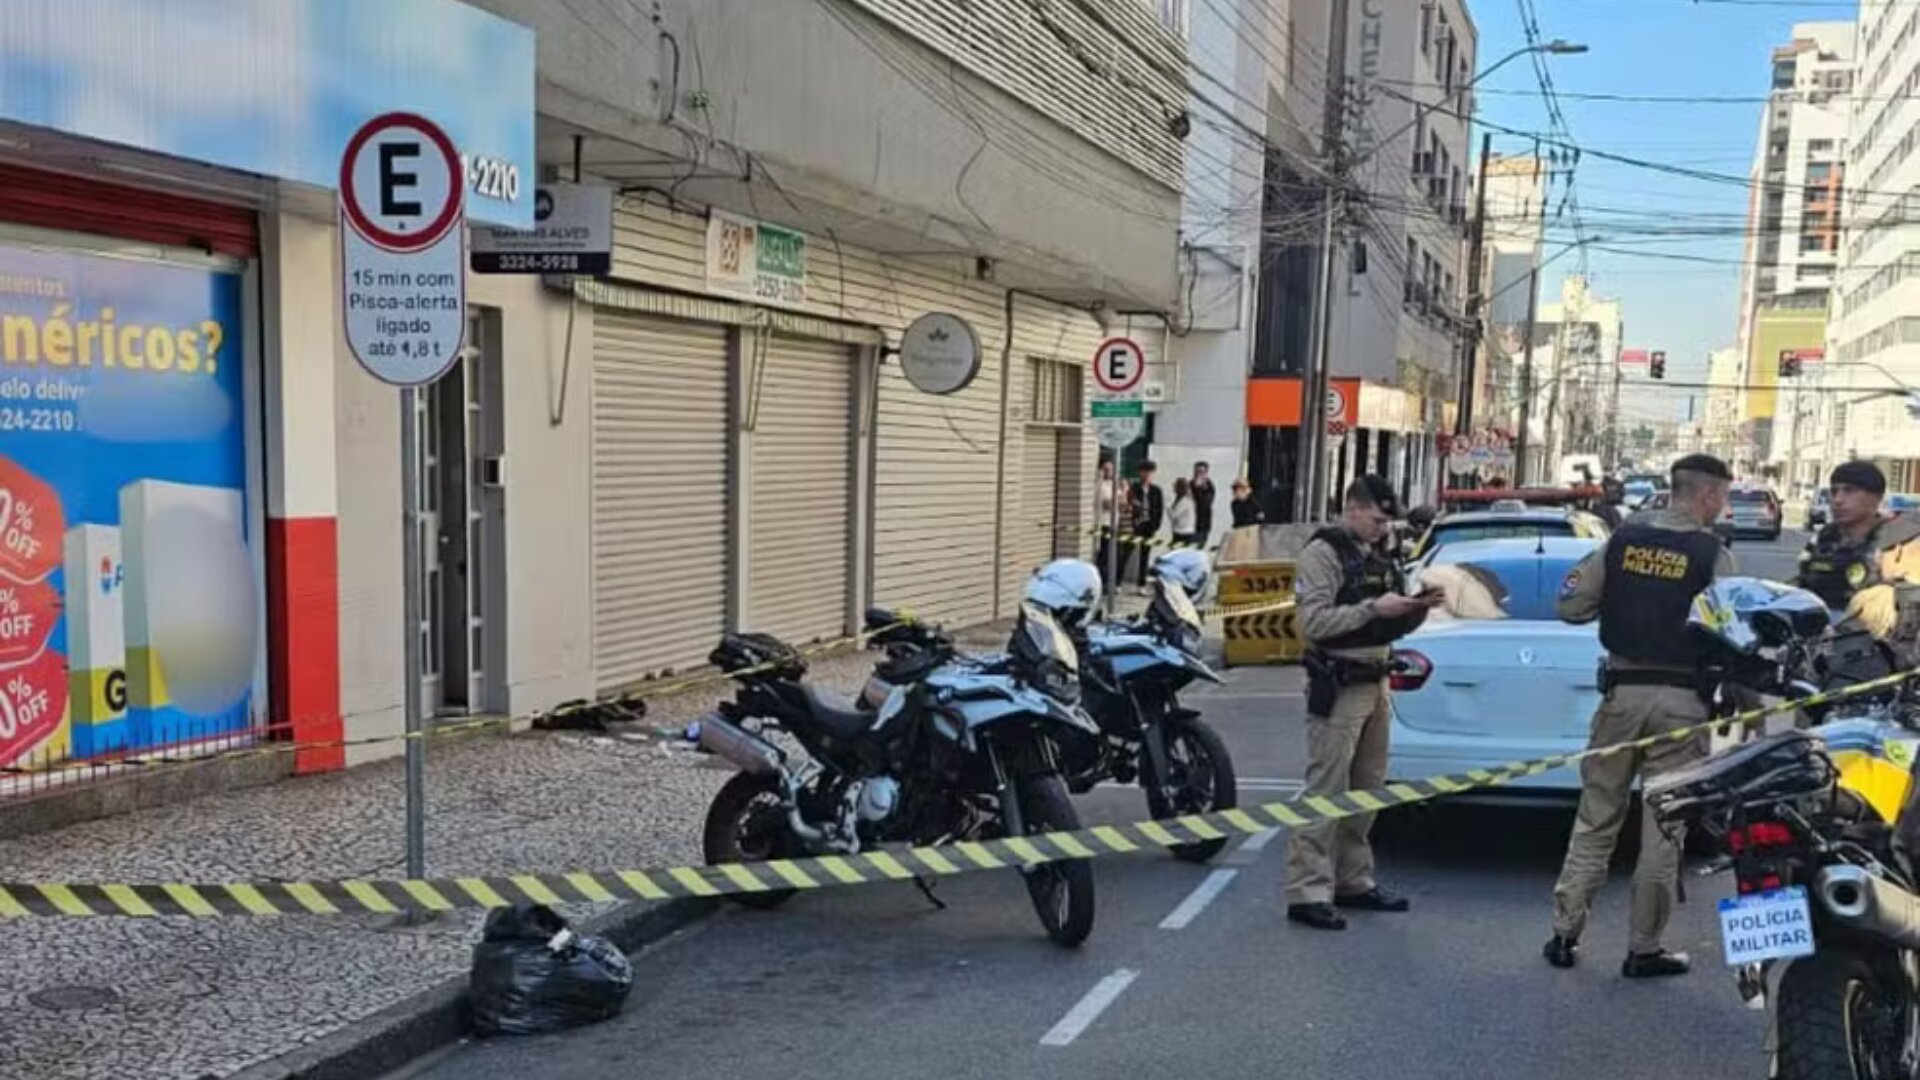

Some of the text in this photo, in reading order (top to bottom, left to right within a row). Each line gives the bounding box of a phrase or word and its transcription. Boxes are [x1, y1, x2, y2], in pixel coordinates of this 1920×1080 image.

[379, 143, 421, 216] E
[499, 255, 578, 270] 3324-5928
[353, 269, 455, 287] 15 min com
[350, 292, 458, 310] Pisca-alerta
[3, 304, 223, 374] néricos?
[376, 317, 431, 337] ligado
[433, 341, 442, 357] t
[1109, 350, 1128, 380] E
[6, 527, 42, 559] OFF
[1623, 557, 1686, 580] MILITAR
[1242, 575, 1292, 593] 3347
[0, 614, 33, 640] OFF
[104, 669, 126, 713] G
[17, 689, 49, 726] OFF
[1731, 928, 1808, 954] MILITAR
